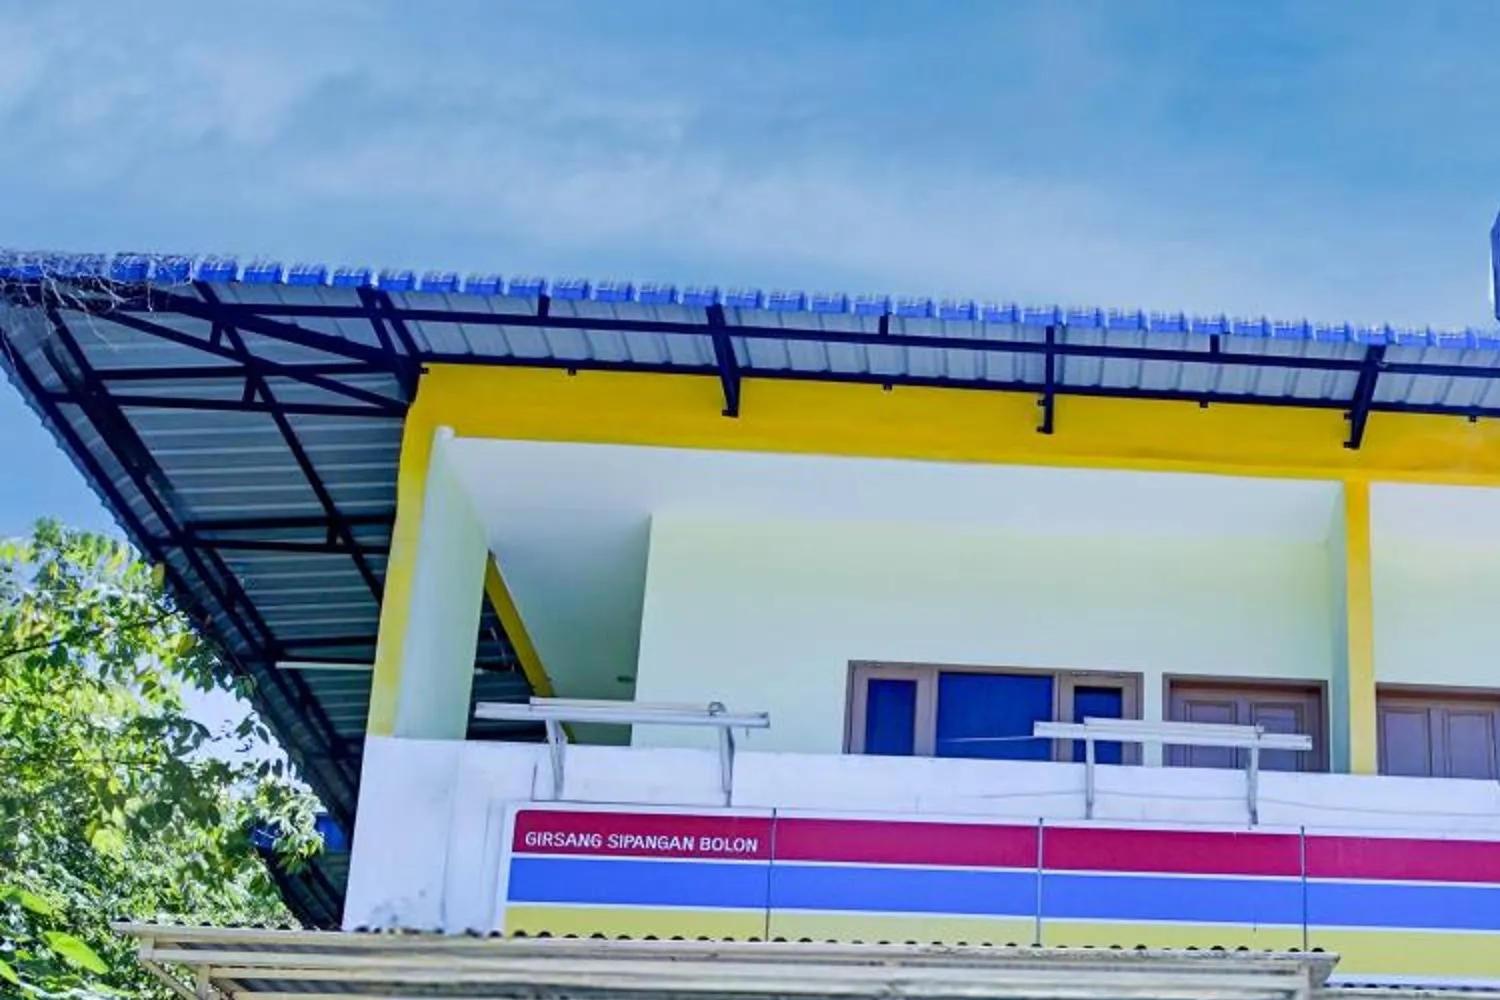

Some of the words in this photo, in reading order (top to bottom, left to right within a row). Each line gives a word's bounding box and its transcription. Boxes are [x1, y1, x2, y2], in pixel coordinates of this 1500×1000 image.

[525, 831, 602, 849] GIRSANG
[607, 833, 694, 851] SIPANGAN
[699, 836, 758, 853] BOLON
